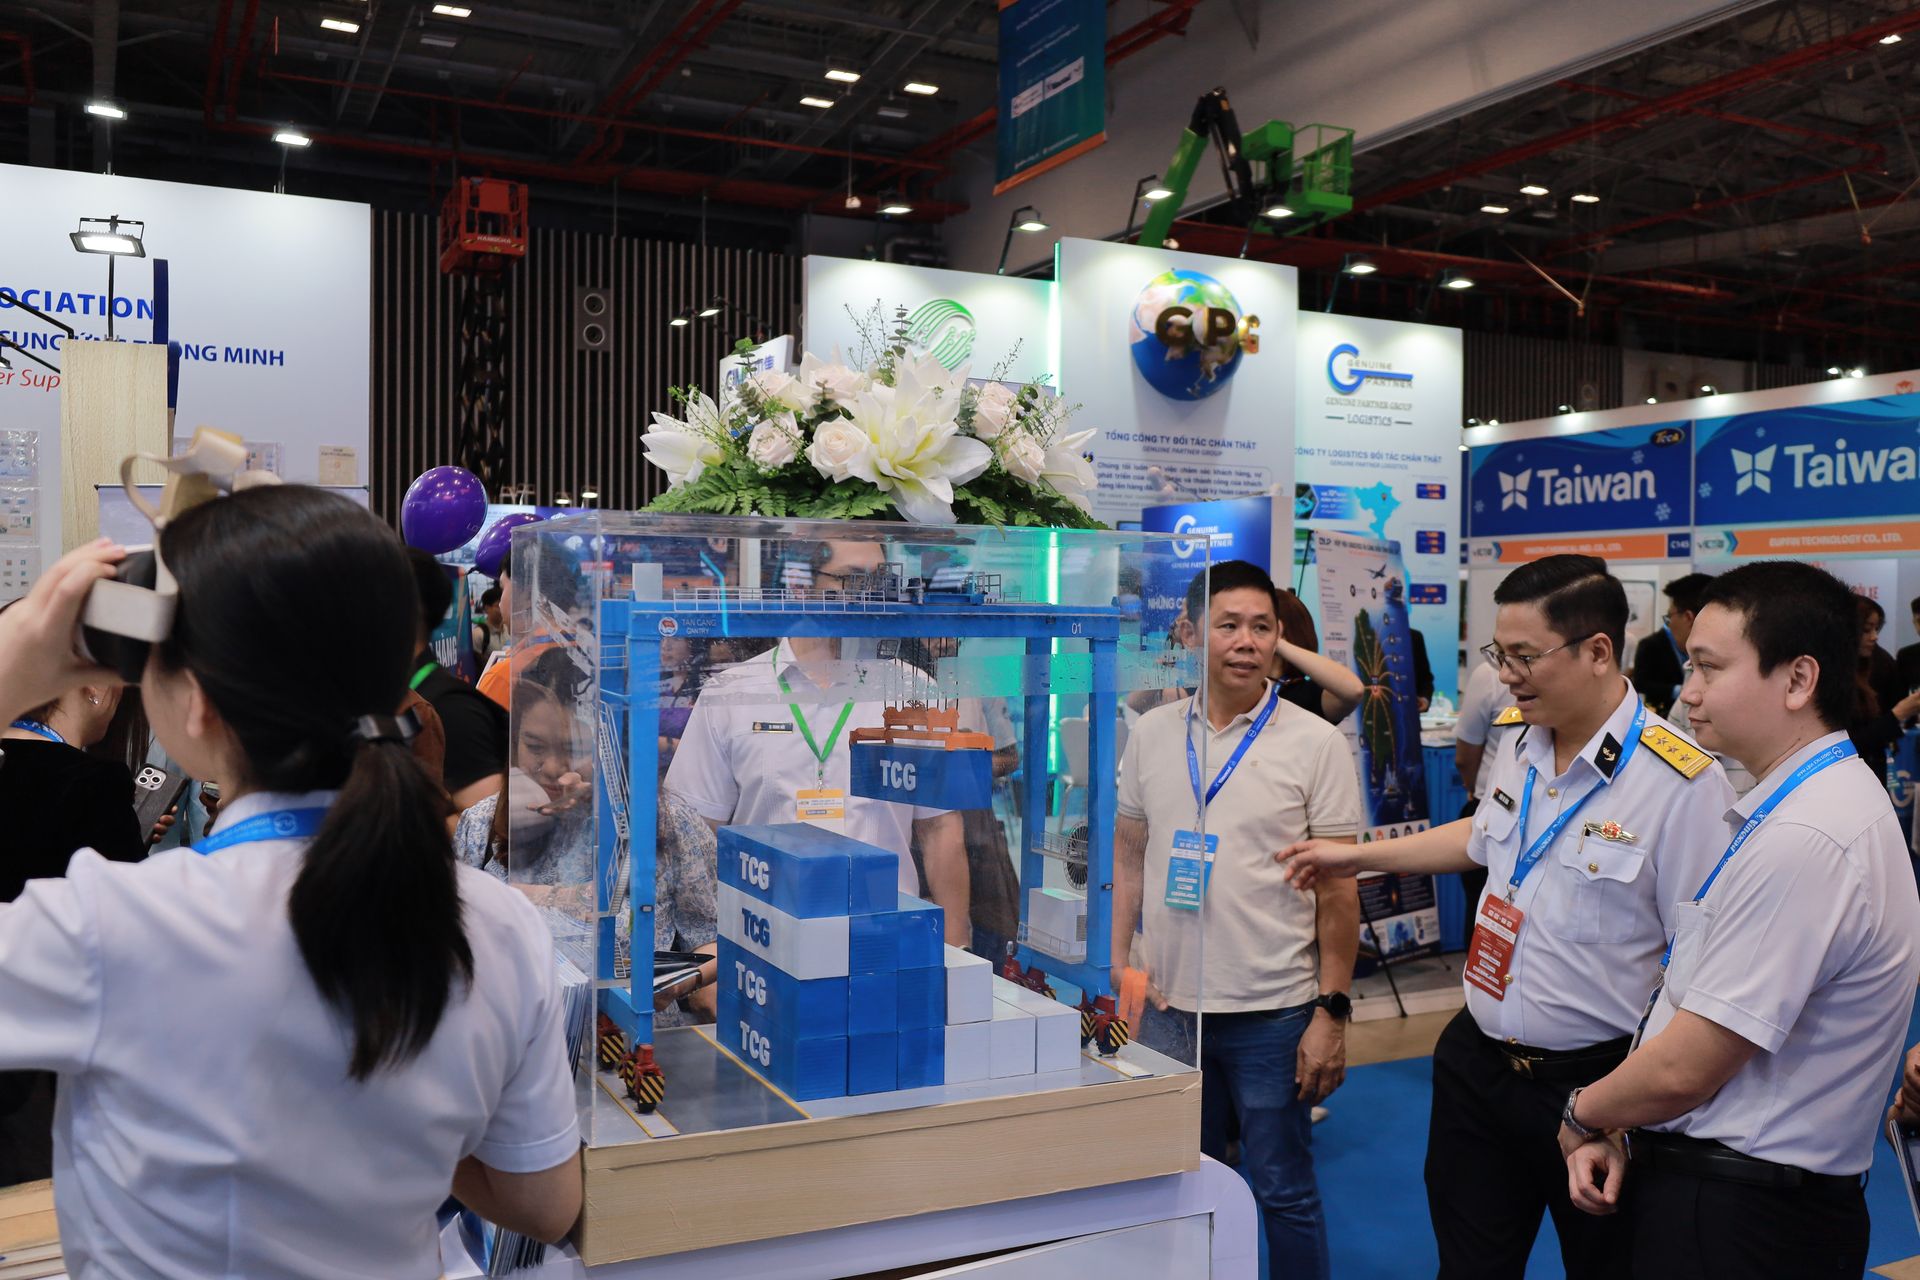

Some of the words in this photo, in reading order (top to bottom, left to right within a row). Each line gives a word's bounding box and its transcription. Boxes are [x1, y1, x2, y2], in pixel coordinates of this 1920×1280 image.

[224, 347, 285, 366] MINH
[1347, 414, 1392, 426] LOGISTICS
[1160, 436, 1170, 444] TY
[1328, 449, 1368, 459] LOGISTICS
[1784, 438, 1920, 488] Taiwa
[1537, 464, 1656, 506] Taiwan
[1187, 525, 1218, 535] GENUINE
[1071, 622, 1082, 635] 01
[879, 759, 916, 791] TCG
[739, 851, 769, 890] TCG
[741, 907, 770, 948] TCG
[735, 960, 766, 1006] TCG
[739, 1020, 770, 1067] TCG
